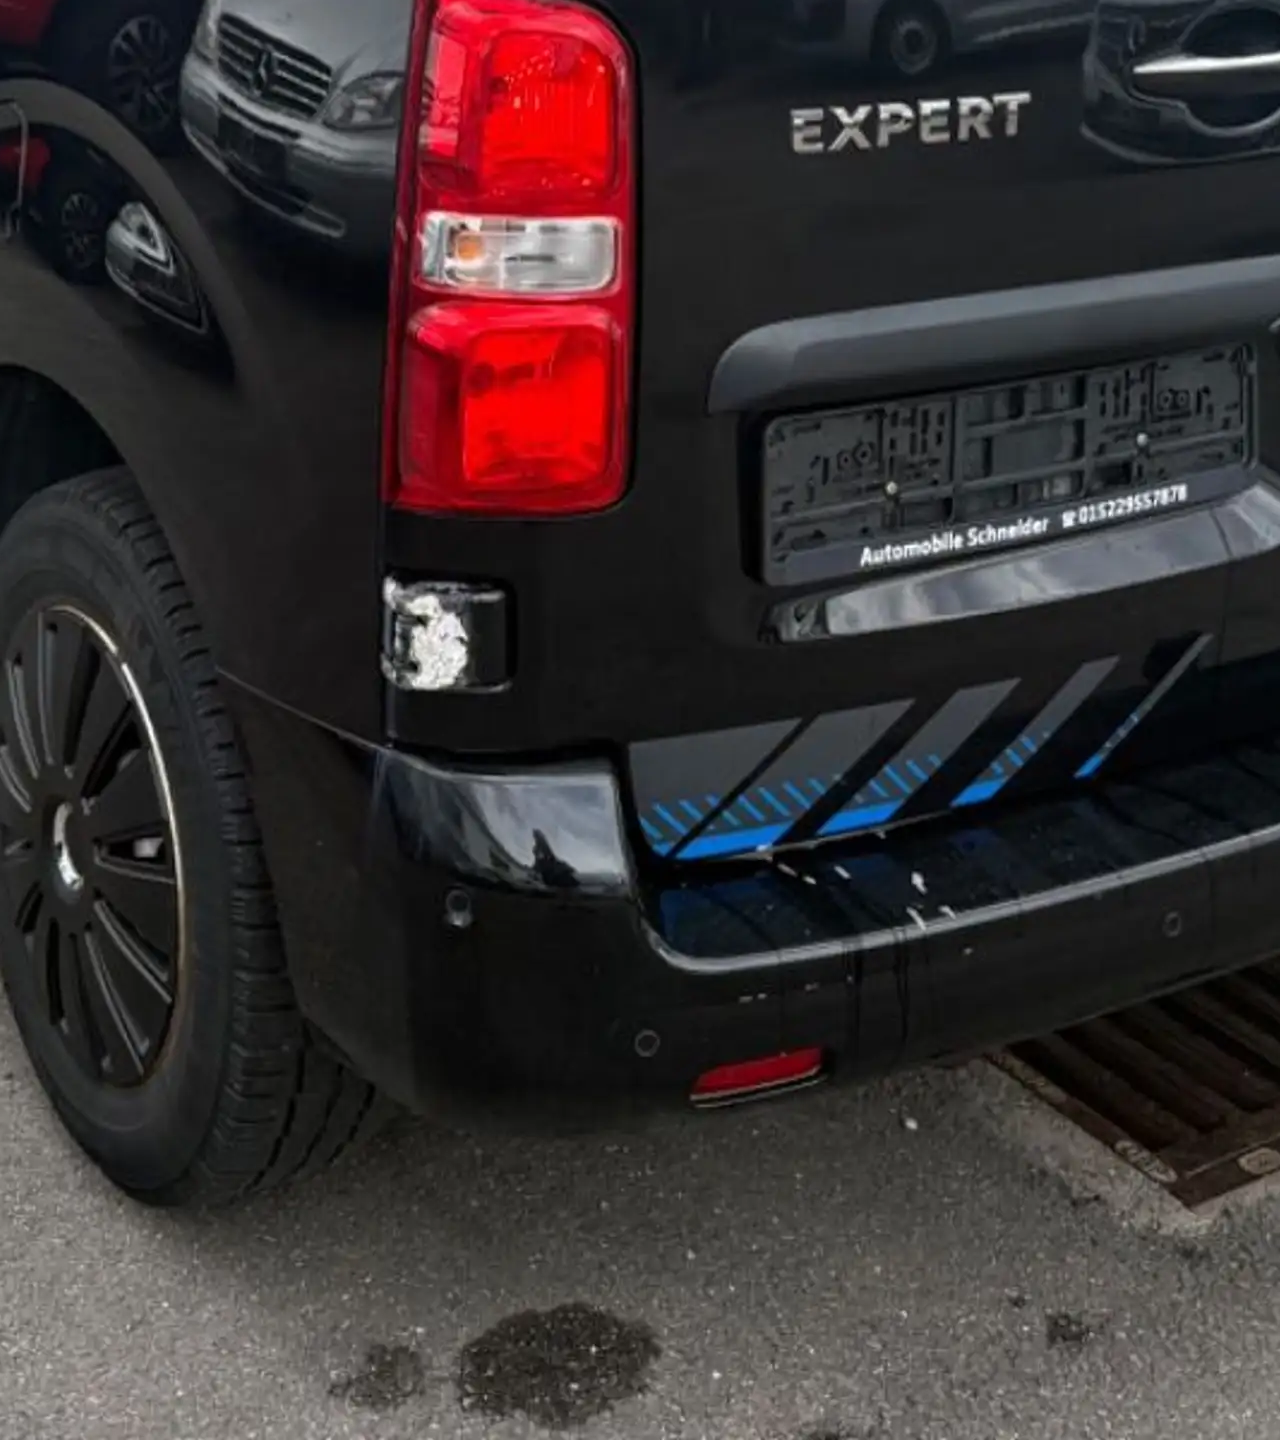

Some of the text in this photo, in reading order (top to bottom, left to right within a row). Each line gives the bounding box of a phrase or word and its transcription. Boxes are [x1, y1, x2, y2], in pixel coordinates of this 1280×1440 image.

[790, 91, 1032, 153] EXPERT
[860, 531, 964, 567] Automobile
[967, 517, 1050, 547] Schneider
